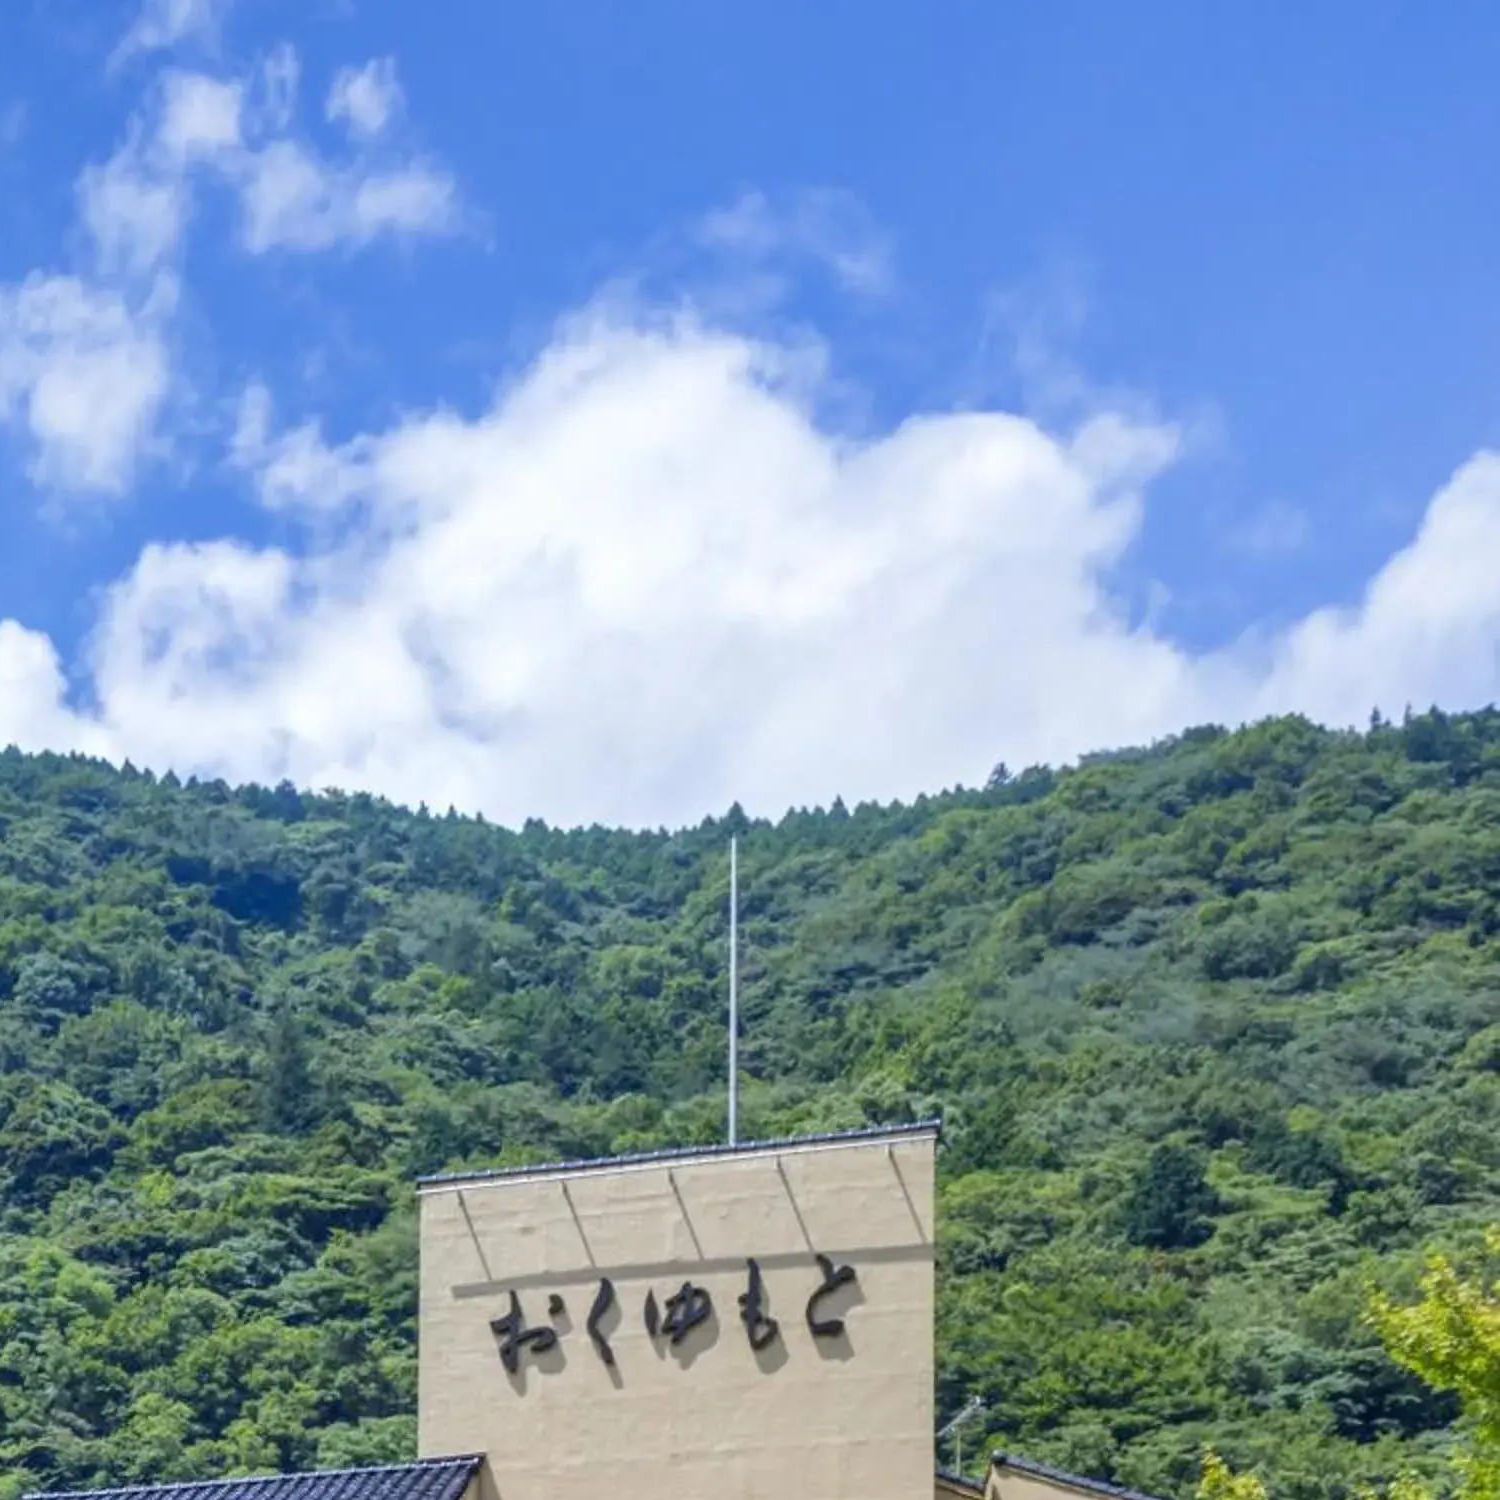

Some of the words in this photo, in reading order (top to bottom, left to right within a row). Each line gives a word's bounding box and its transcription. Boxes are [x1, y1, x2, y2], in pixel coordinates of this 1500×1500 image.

[490, 1254, 856, 1374] おくゆもと
